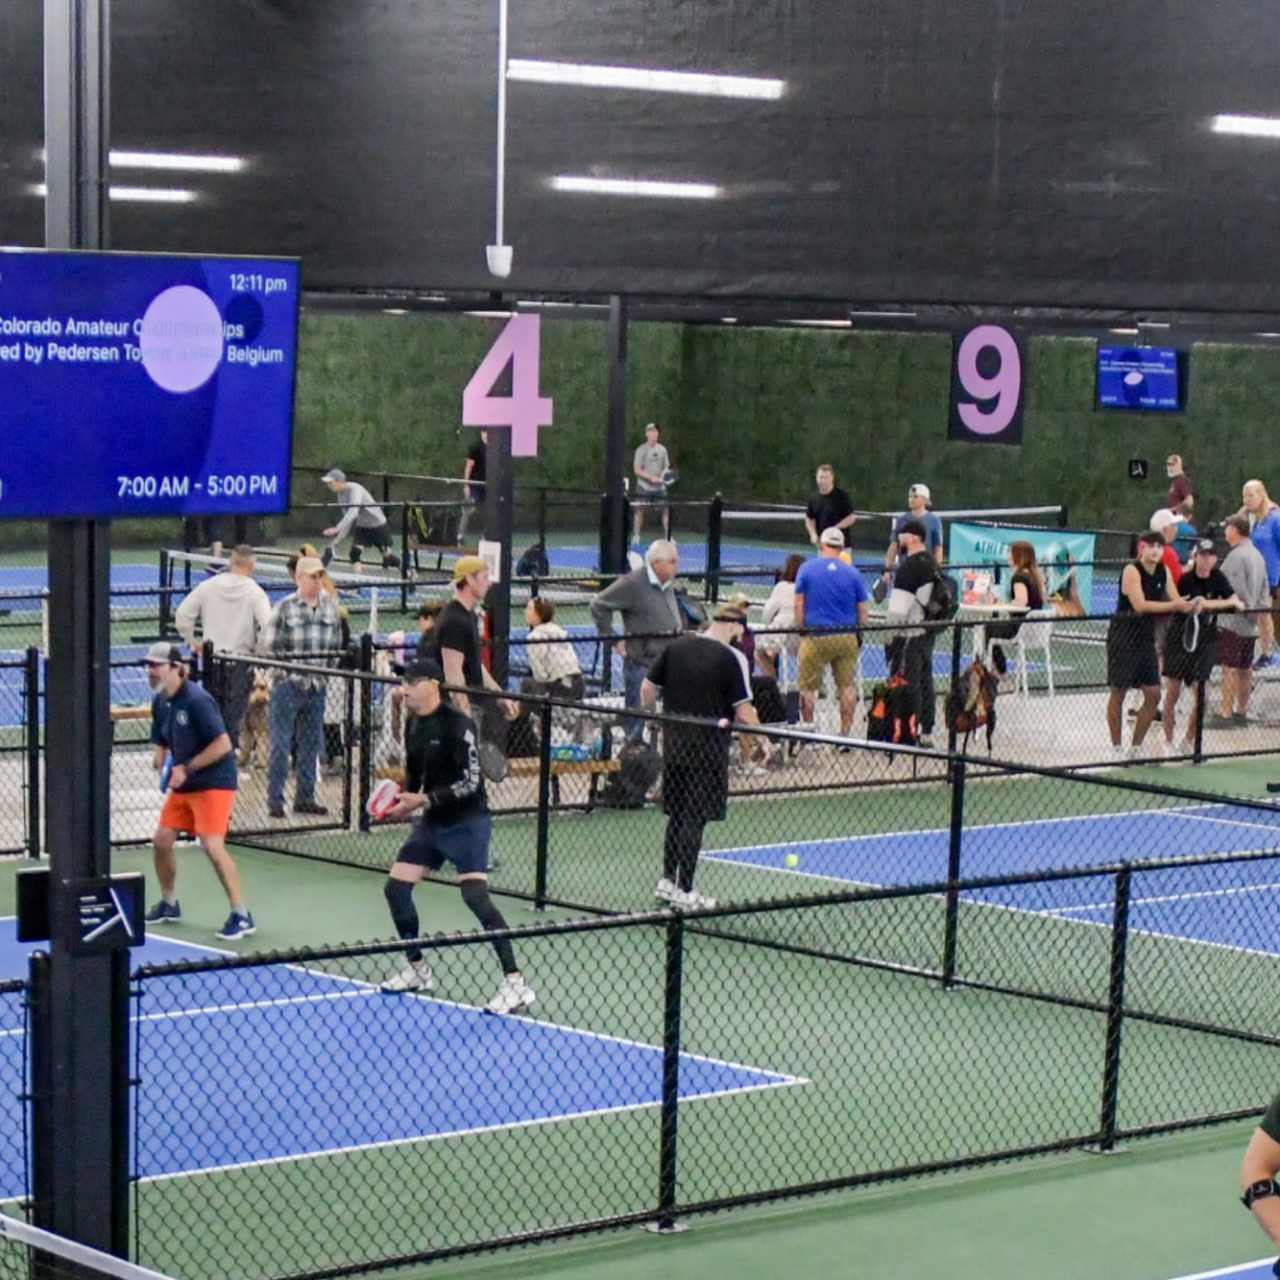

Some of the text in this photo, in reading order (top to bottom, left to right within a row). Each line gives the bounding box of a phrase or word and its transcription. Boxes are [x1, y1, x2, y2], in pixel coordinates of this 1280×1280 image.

[230, 273, 288, 295] 12:11 pm
[64, 317, 129, 336] Amateur
[23, 342, 44, 364] by
[46, 342, 120, 362] Pedersen
[226, 344, 285, 368] Belgium
[462, 313, 553, 456] 4
[957, 325, 1022, 434] 9
[116, 475, 157, 498] 7:00
[158, 474, 190, 497] AM
[207, 473, 246, 496] 5:00
[248, 473, 278, 495] PM
